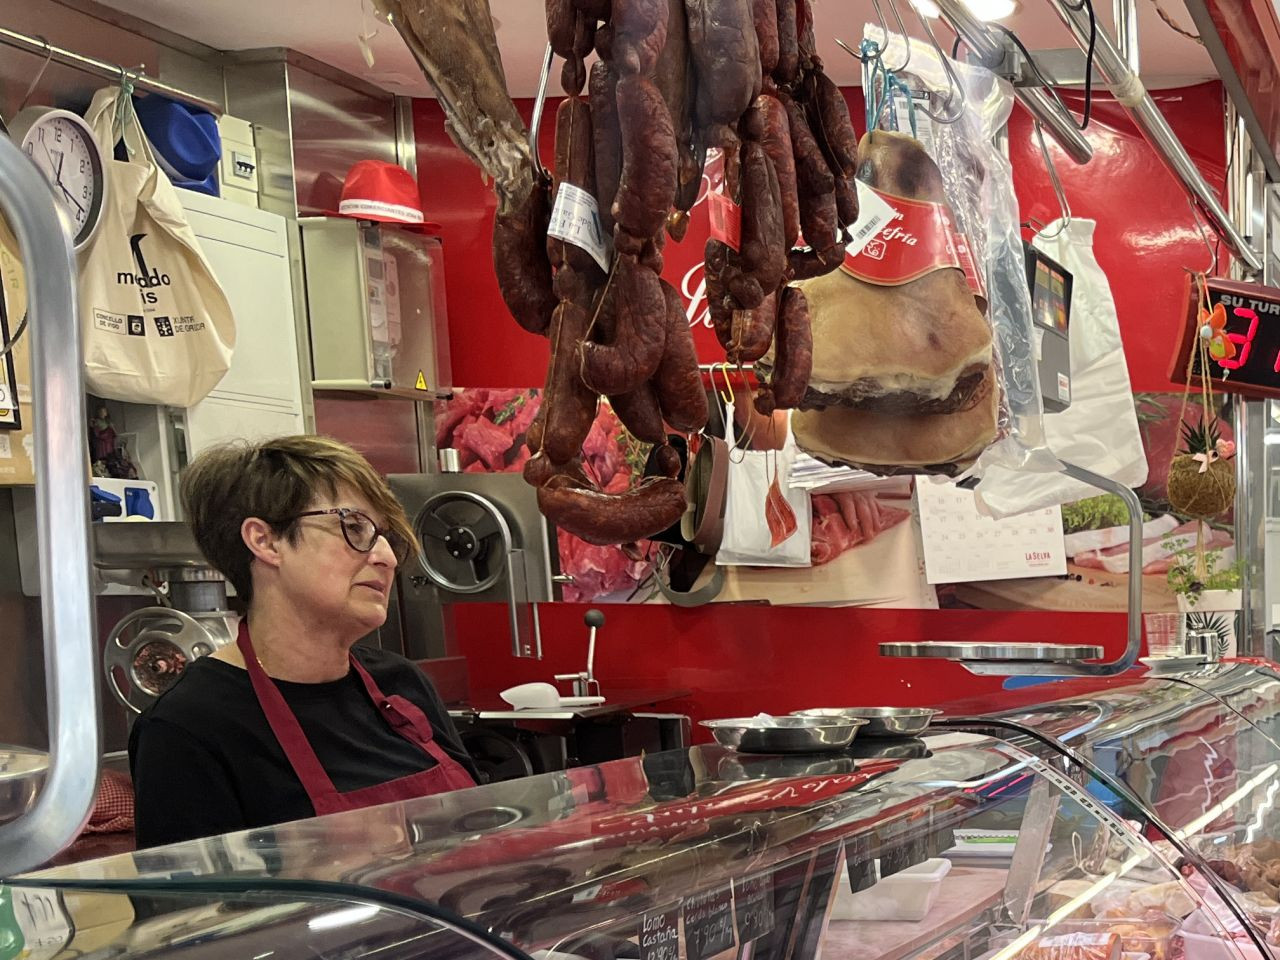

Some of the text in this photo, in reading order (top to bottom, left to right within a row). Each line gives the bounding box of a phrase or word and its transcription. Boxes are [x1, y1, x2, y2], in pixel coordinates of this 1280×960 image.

[80, 160, 85, 173] 2
[83, 186, 88, 199] 3
[1220, 295, 1244, 308] SU
[643, 913, 665, 933] Lomo
[642, 925, 679, 947] Castaña
